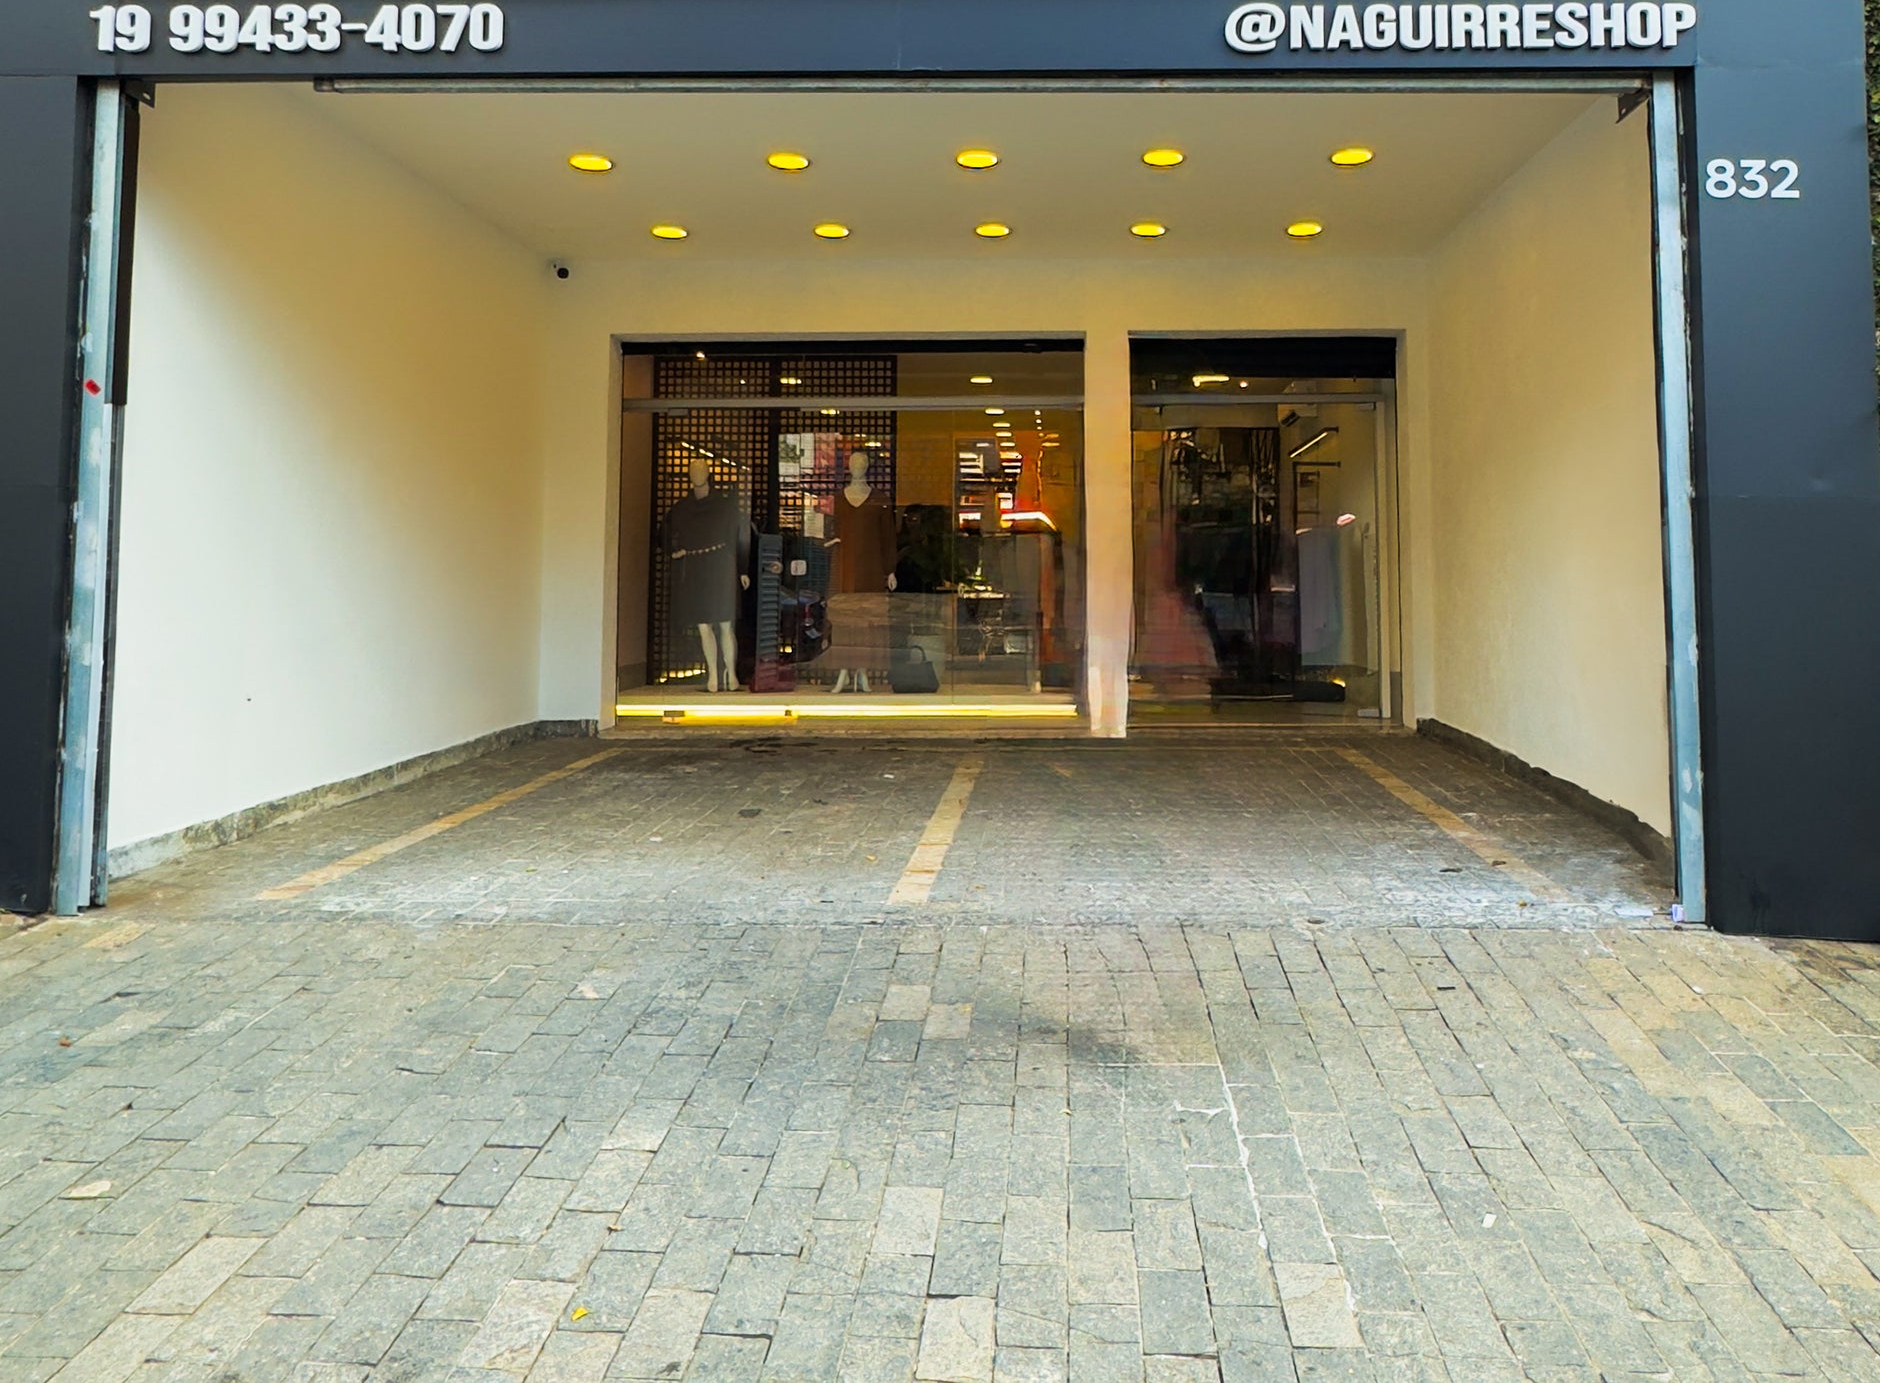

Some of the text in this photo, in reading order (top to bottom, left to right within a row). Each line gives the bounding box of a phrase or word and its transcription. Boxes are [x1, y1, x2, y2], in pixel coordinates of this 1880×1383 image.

[90, 3, 505, 53] 19 99433-4070
[1224, 1, 1697, 53] @NAGUIRRESHOP
[1705, 158, 1801, 199] 832
